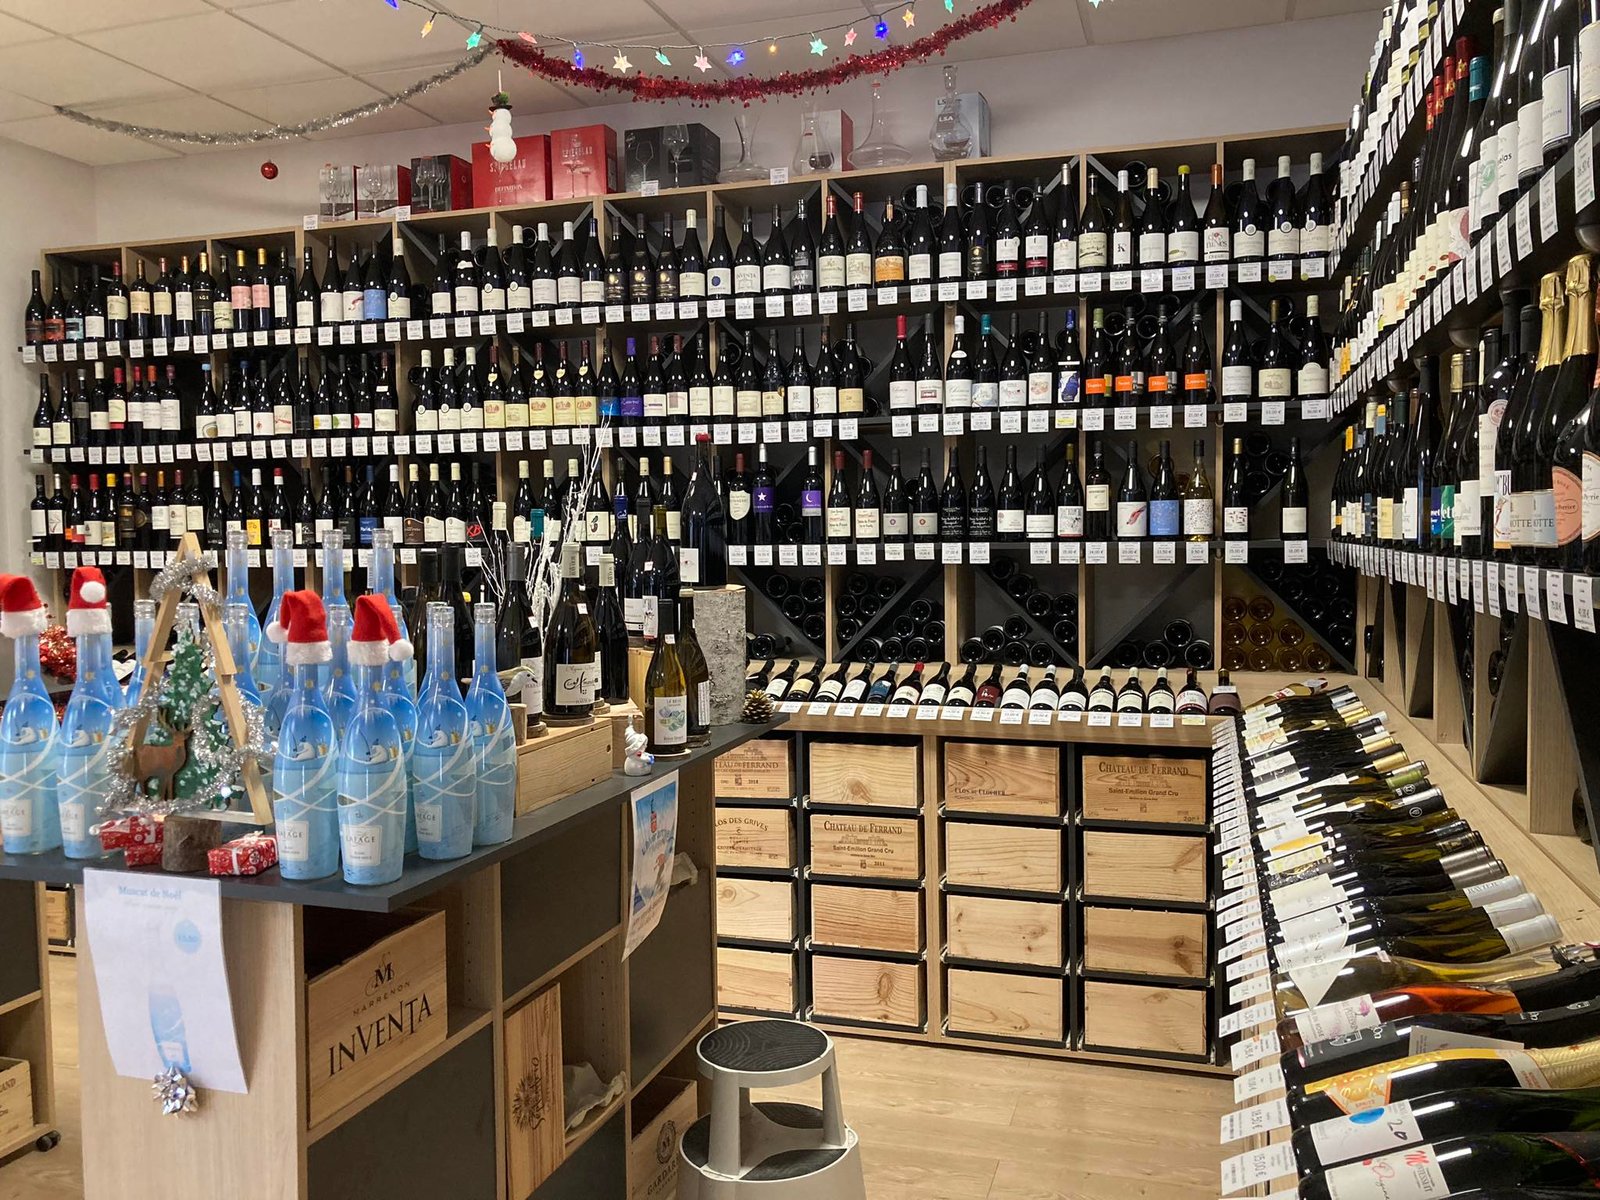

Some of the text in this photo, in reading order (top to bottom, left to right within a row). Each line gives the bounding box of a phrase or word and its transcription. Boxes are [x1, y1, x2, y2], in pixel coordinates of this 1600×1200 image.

[1098, 761, 1189, 776] CHATEAU DE FERRAND
[823, 820, 903, 835] CHATEAU DE FERRAND
[328, 992, 432, 1077] INVENTA
